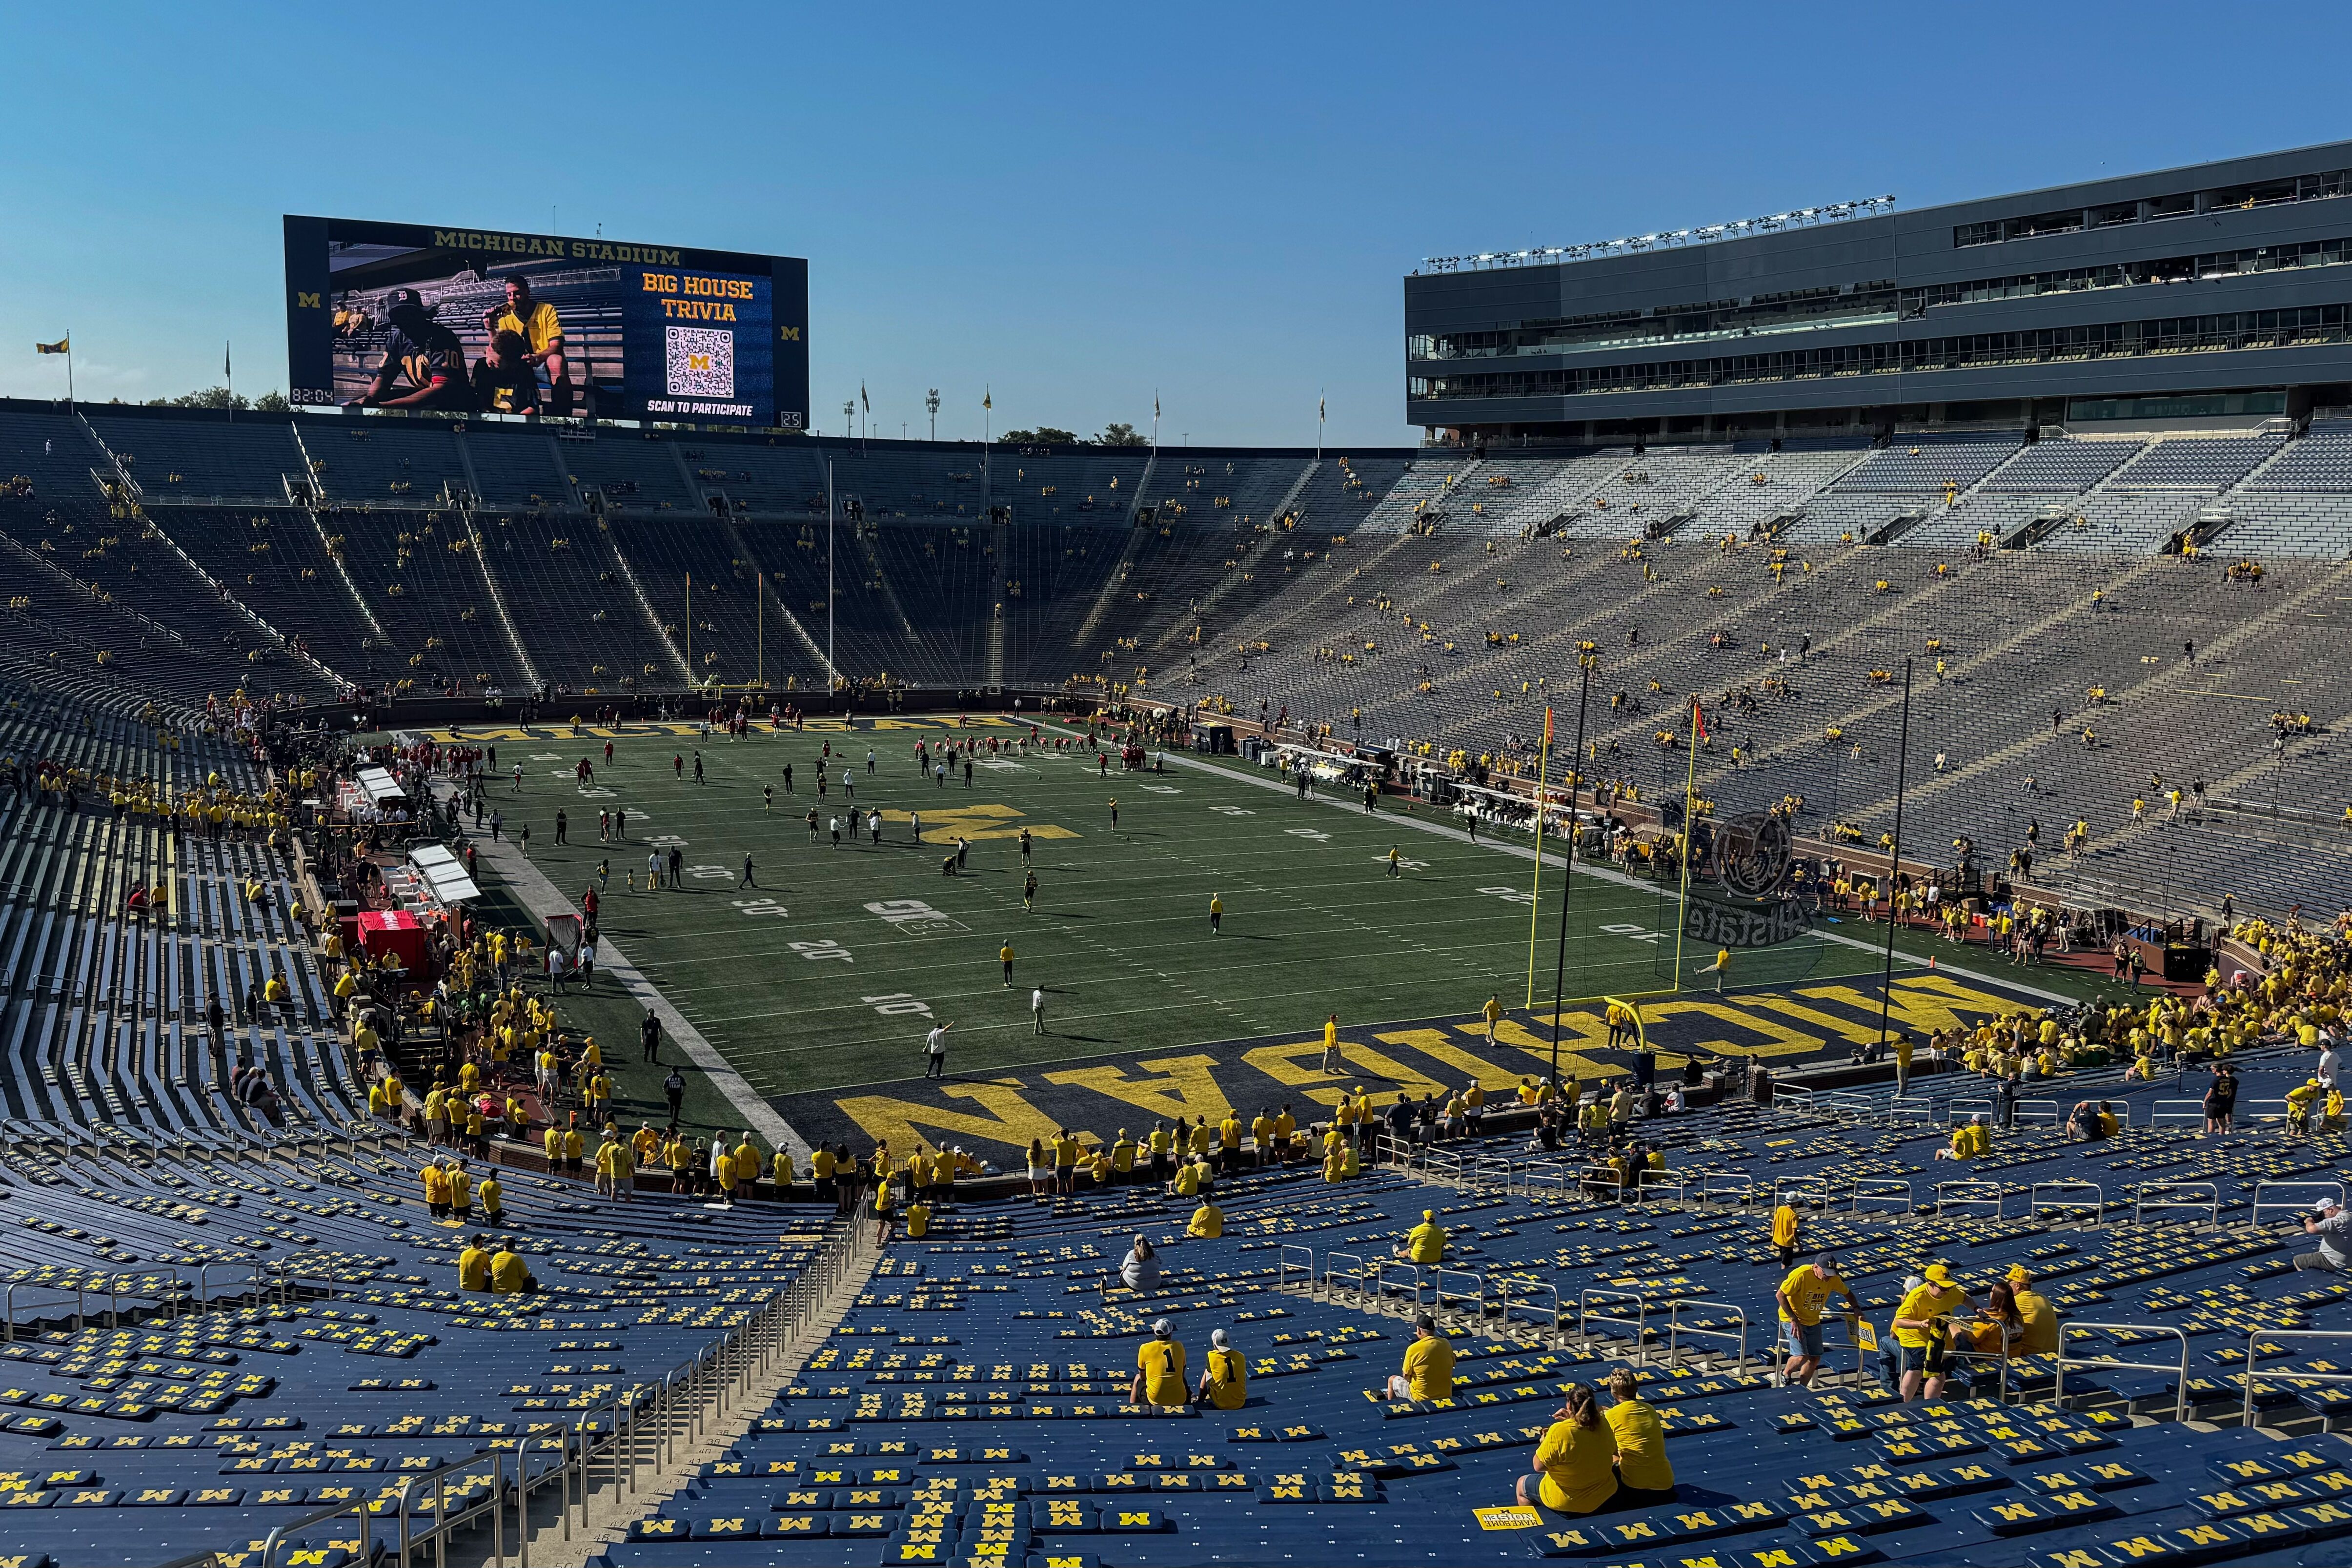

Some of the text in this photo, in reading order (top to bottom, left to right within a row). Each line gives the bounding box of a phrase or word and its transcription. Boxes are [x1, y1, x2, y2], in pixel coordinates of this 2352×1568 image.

[435, 231, 680, 266] MICHIGAN STADIUM
[642, 273, 753, 300] BIG HOUSE
[298, 292, 320, 308] M
[661, 299, 737, 322] TRIVIA
[781, 326, 800, 341] M
[689, 353, 710, 370] M
[292, 389, 333, 403] 82:04
[647, 399, 753, 416] SCAN TO PARTICIPATE
[784, 414, 799, 426] 25
[861, 803, 1085, 845] M
[684, 865, 734, 878] 40
[730, 898, 789, 916] 30
[787, 939, 853, 960] 20
[860, 993, 931, 1015] 10
[834, 975, 2041, 1166] MICHIGAN
[1428, 1110, 1434, 1120] 9
[1983, 1130, 1988, 1143] 1
[2274, 1317, 2299, 1326] M
[1162, 1348, 1176, 1373] 1
[2216, 1348, 2244, 1360] M
[1224, 1356, 1237, 1383] 1
[1514, 1386, 1538, 1397] M
[1697, 1381, 1723, 1392] M
[42, 1393, 67, 1404] M
[2316, 1389, 2351, 1402] M
[80, 1398, 105, 1409] M
[190, 1400, 213, 1408] M
[1074, 1406, 1095, 1415] M
[1389, 1403, 1413, 1413] M
[2023, 1403, 2055, 1417] M
[20, 1417, 48, 1427] M
[216, 1418, 240, 1427] M
[809, 1419, 831, 1428] M
[1978, 1412, 2010, 1425] M
[2086, 1410, 2119, 1424] M
[1931, 1420, 1963, 1433] M
[2037, 1418, 2070, 1432] M
[1236, 1427, 1261, 1438] M
[1885, 1426, 1918, 1441] M
[1986, 1426, 2021, 1440] M
[2065, 1430, 2102, 1444] M
[115, 1437, 142, 1446] M
[830, 1443, 854, 1453] M
[1936, 1434, 1971, 1448] M
[2006, 1439, 2043, 1454] M
[1884, 1442, 1922, 1456] M
[1409, 1453, 1440, 1467] M
[2282, 1451, 2325, 1468] M
[714, 1463, 741, 1473] M
[1853, 1464, 1891, 1479] M
[1953, 1465, 1991, 1481] M
[2091, 1463, 2133, 1479] M
[2227, 1460, 2271, 1477] M
[1799, 1474, 1836, 1489] M
[1898, 1473, 1938, 1489] M
[2036, 1473, 2077, 1489] M
[2313, 1471, 2352, 1491] M
[197, 1489, 232, 1502] M
[259, 1489, 292, 1503] M
[318, 1487, 352, 1499] M
[850, 1490, 881, 1504] M
[1271, 1486, 1303, 1499] M
[1845, 1482, 1885, 1498] M
[2254, 1483, 2301, 1500] M
[8, 1492, 45, 1505] M
[73, 1491, 107, 1504] M
[1789, 1492, 1831, 1510] M
[2051, 1492, 2097, 1510] M
[2200, 1491, 2248, 1510] M
[1732, 1502, 1773, 1519] M
[1868, 1499, 1911, 1518] M
[1992, 1503, 2037, 1521] M
[2300, 1504, 2352, 1523] M
[709, 1518, 745, 1532] M
[777, 1517, 813, 1531] M
[850, 1515, 883, 1529] M
[910, 1514, 946, 1528] M
[982, 1513, 1015, 1527] M
[1050, 1512, 1083, 1526] M
[1118, 1512, 1151, 1526] M
[1676, 1511, 1717, 1530] M
[1808, 1511, 1851, 1529] M
[2234, 1513, 2290, 1533] M
[642, 1519, 675, 1534] M
[1616, 1522, 1657, 1540] M
[908, 1529, 942, 1543] M
[980, 1529, 1014, 1542] M
[1547, 1530, 1589, 1548] M
[2175, 1525, 2230, 1546] M
[899, 1544, 937, 1560] M
[974, 1542, 1010, 1556] M
[1815, 1536, 1861, 1557] M
[2111, 1536, 2167, 1558] M
[1752, 1549, 1797, 1568] M
[2047, 1549, 2103, 1568] M
